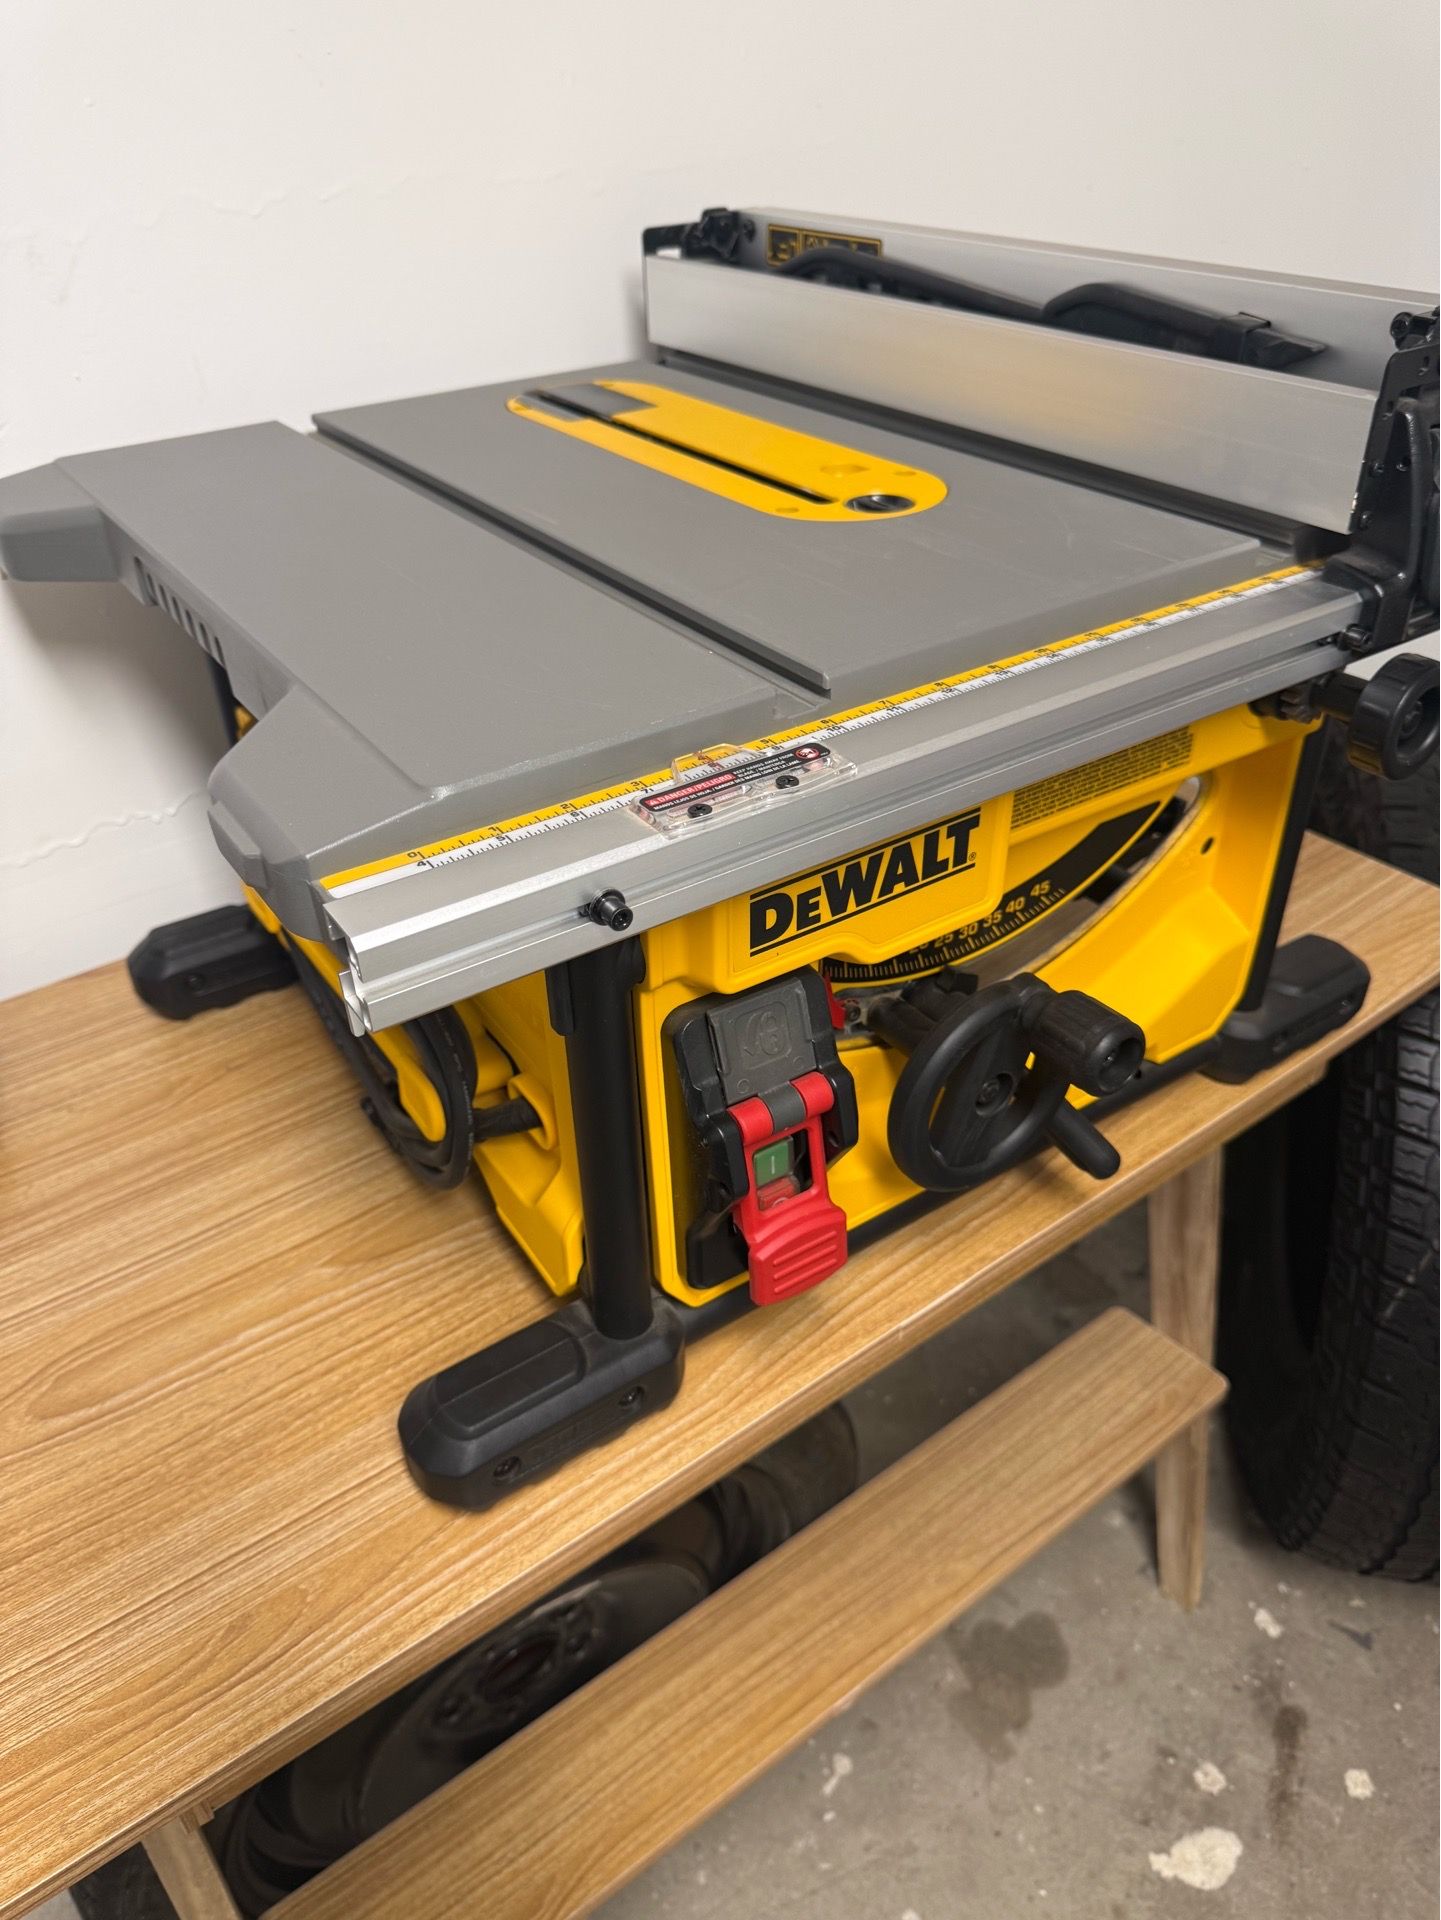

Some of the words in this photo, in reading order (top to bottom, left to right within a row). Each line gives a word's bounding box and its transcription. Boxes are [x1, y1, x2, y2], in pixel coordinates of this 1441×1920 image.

[958, 923, 978, 939] 30
[982, 911, 1002, 928] 35
[1005, 897, 1026, 913] 40
[1030, 880, 1050, 897] 45
